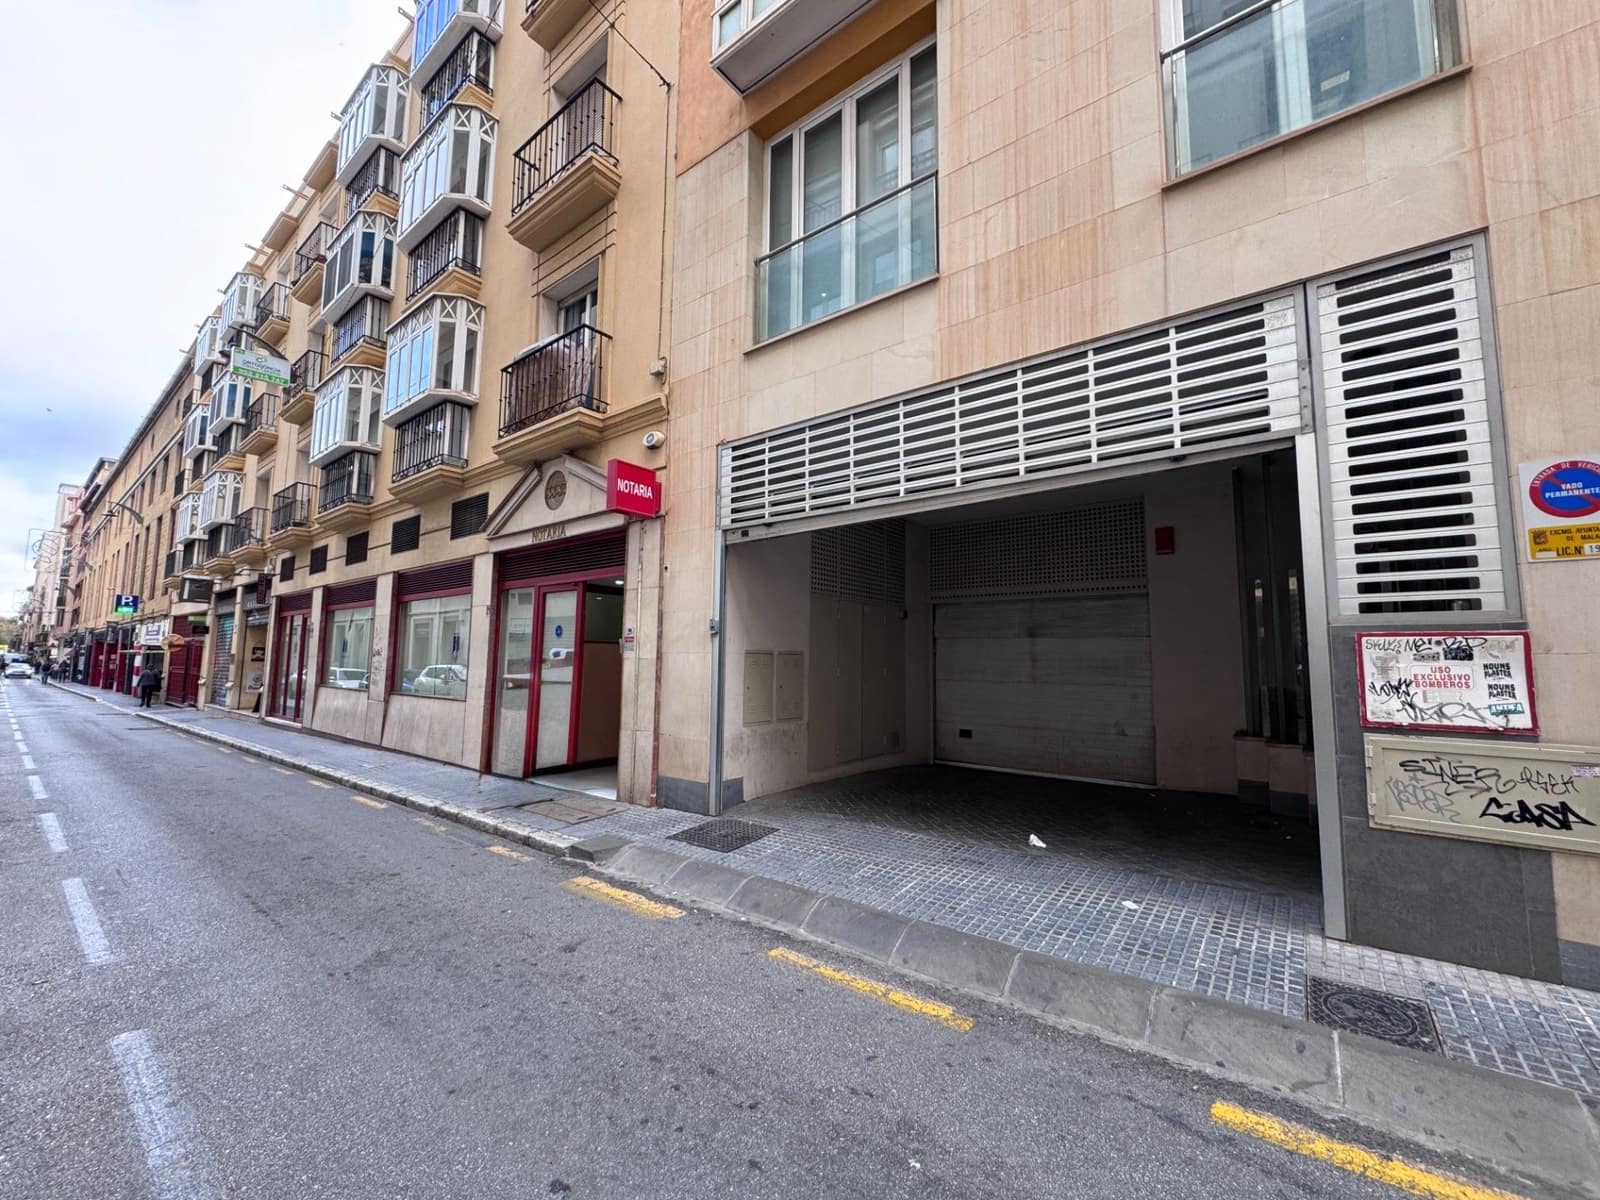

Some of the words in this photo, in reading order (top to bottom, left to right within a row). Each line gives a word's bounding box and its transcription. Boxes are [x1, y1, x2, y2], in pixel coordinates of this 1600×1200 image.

[617, 478, 653, 499] NOTARIA
[1561, 482, 1583, 490] VADO
[1545, 487, 1600, 498] PERMANENTE
[531, 524, 567, 543] NOTARIA
[1431, 666, 1451, 674] USO
[1484, 669, 1512, 679] PLASTER
[1413, 674, 1471, 682] EXCLUSIVO
[1414, 680, 1471, 689] BOMBEROS
[1488, 690, 1517, 700] PLASTER
